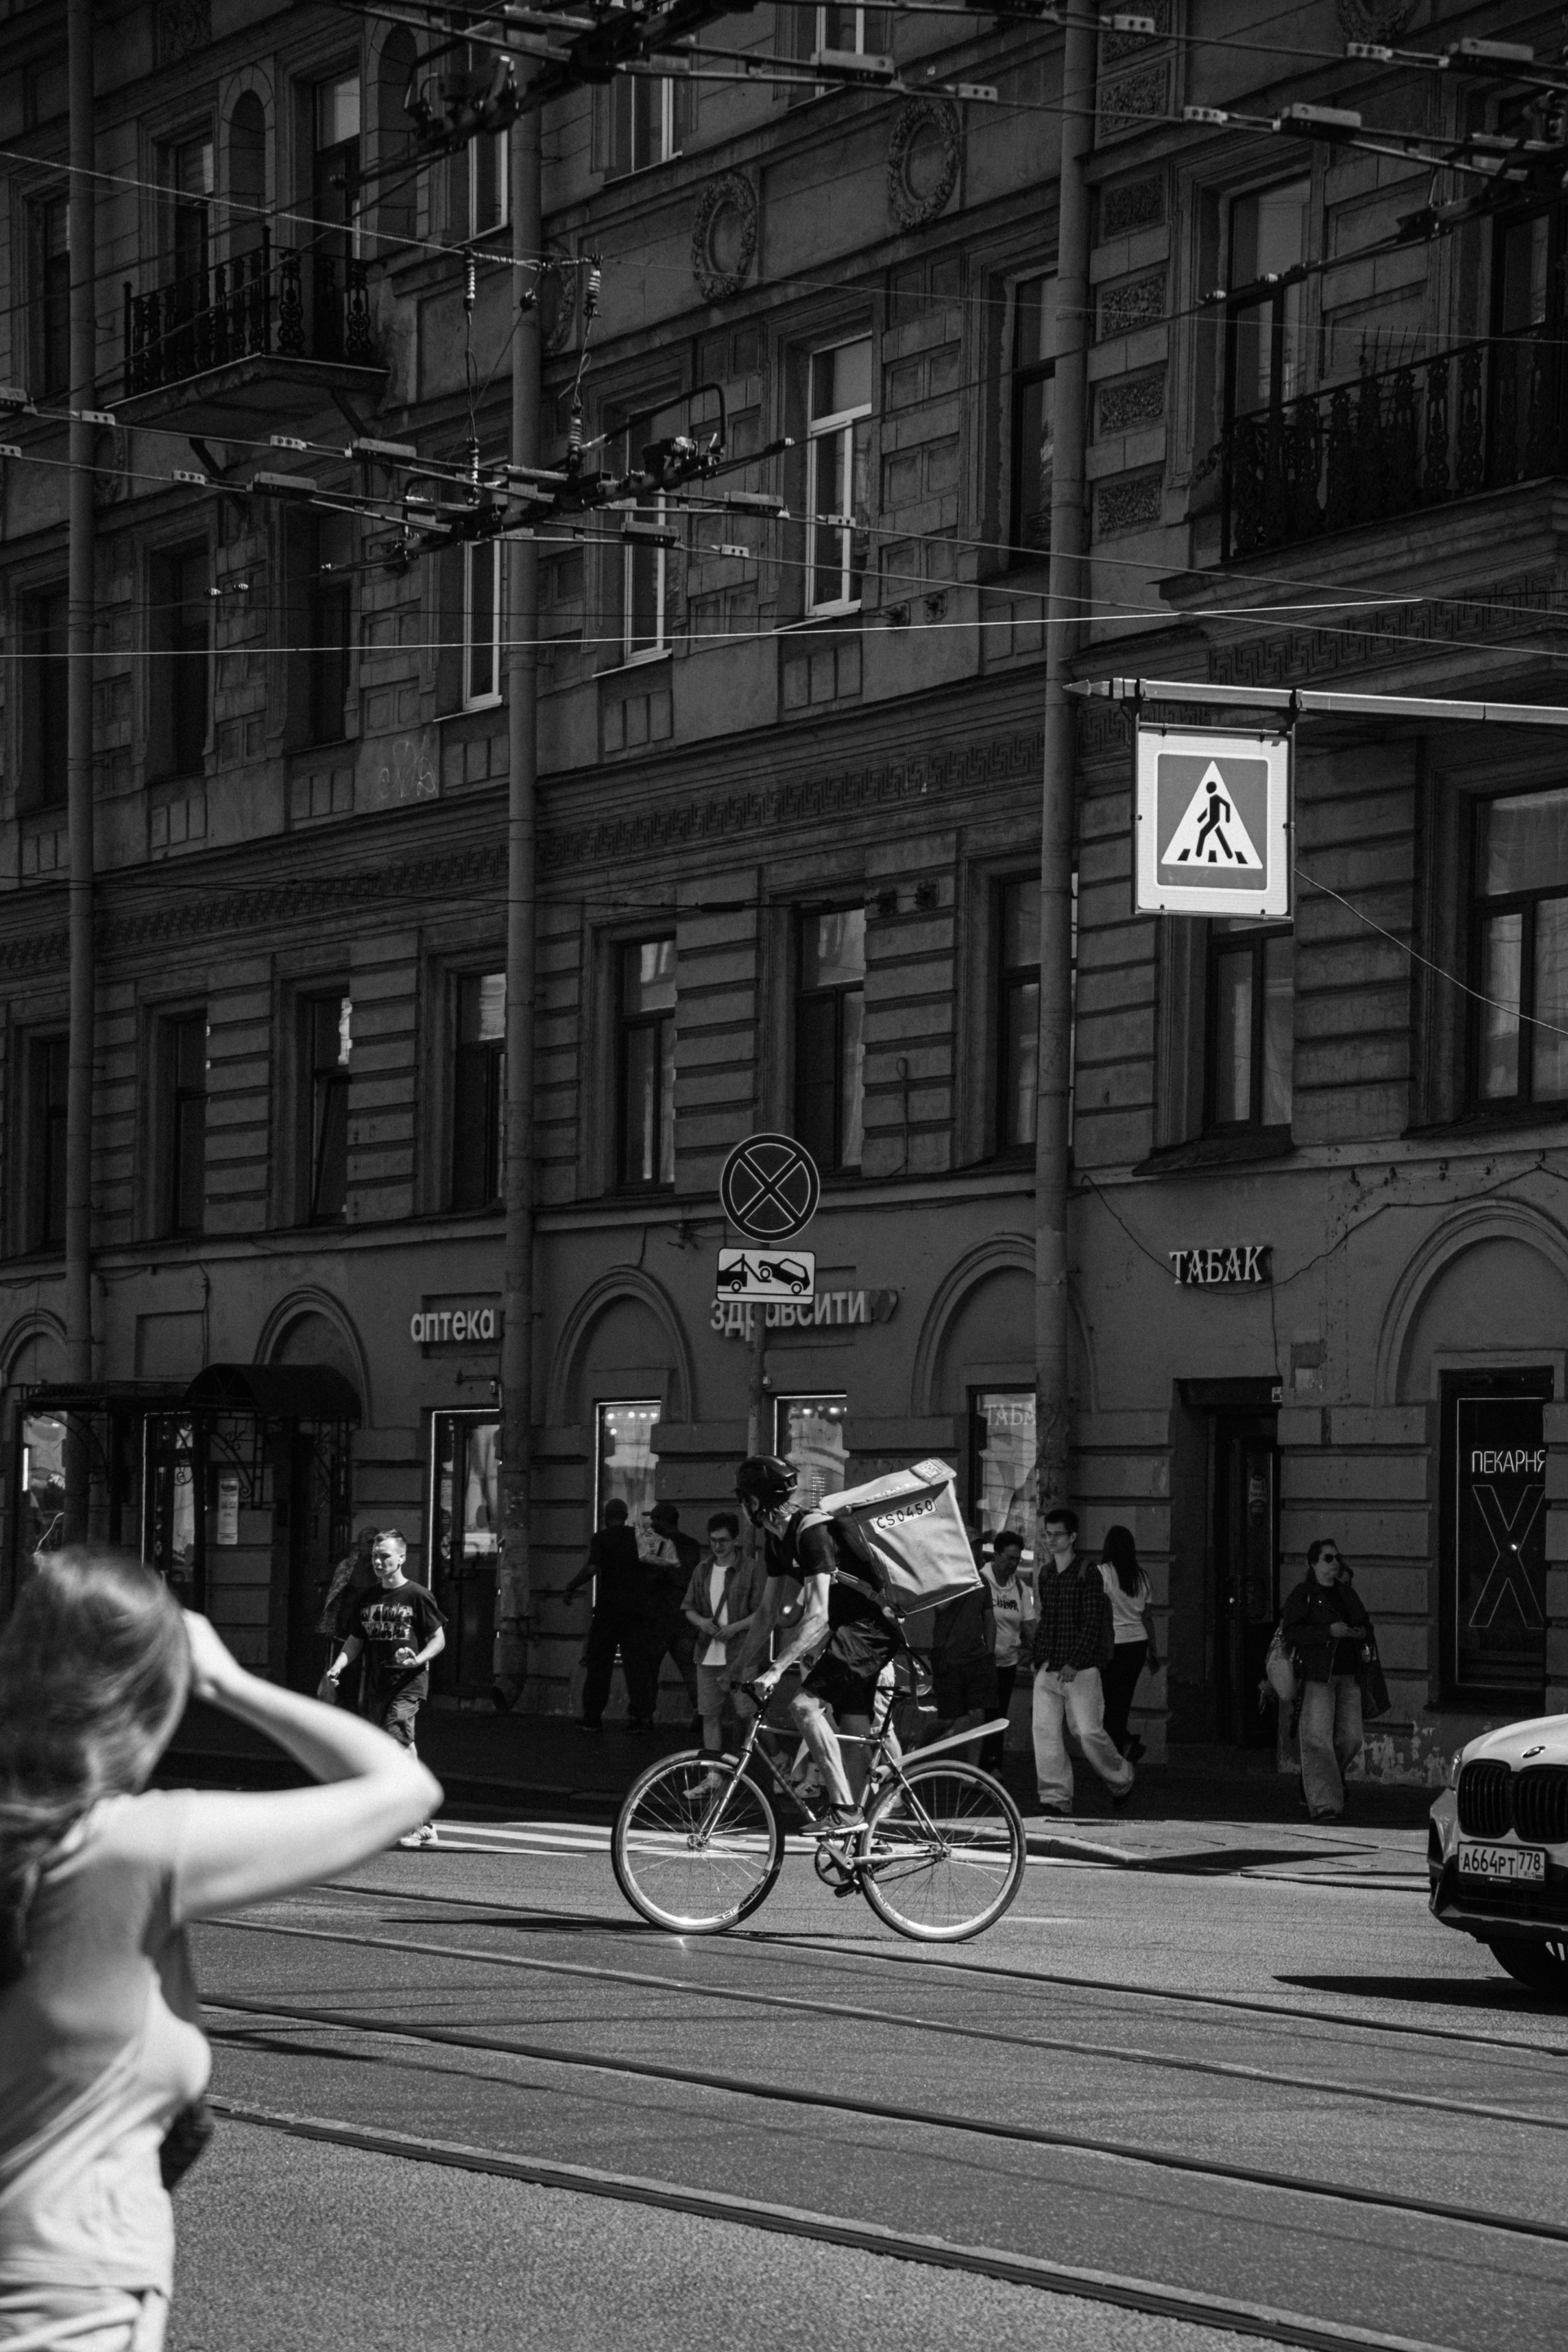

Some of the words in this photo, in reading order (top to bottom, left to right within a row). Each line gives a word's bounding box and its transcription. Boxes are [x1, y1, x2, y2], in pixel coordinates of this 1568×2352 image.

[1169, 1246, 1264, 1284] ТАБАК
[411, 1309, 494, 1342] аптека
[1472, 1450, 1545, 1473] ПЕКАРНЯ
[876, 1500, 932, 1529] CS0450
[1519, 1852, 1540, 1871] 778
